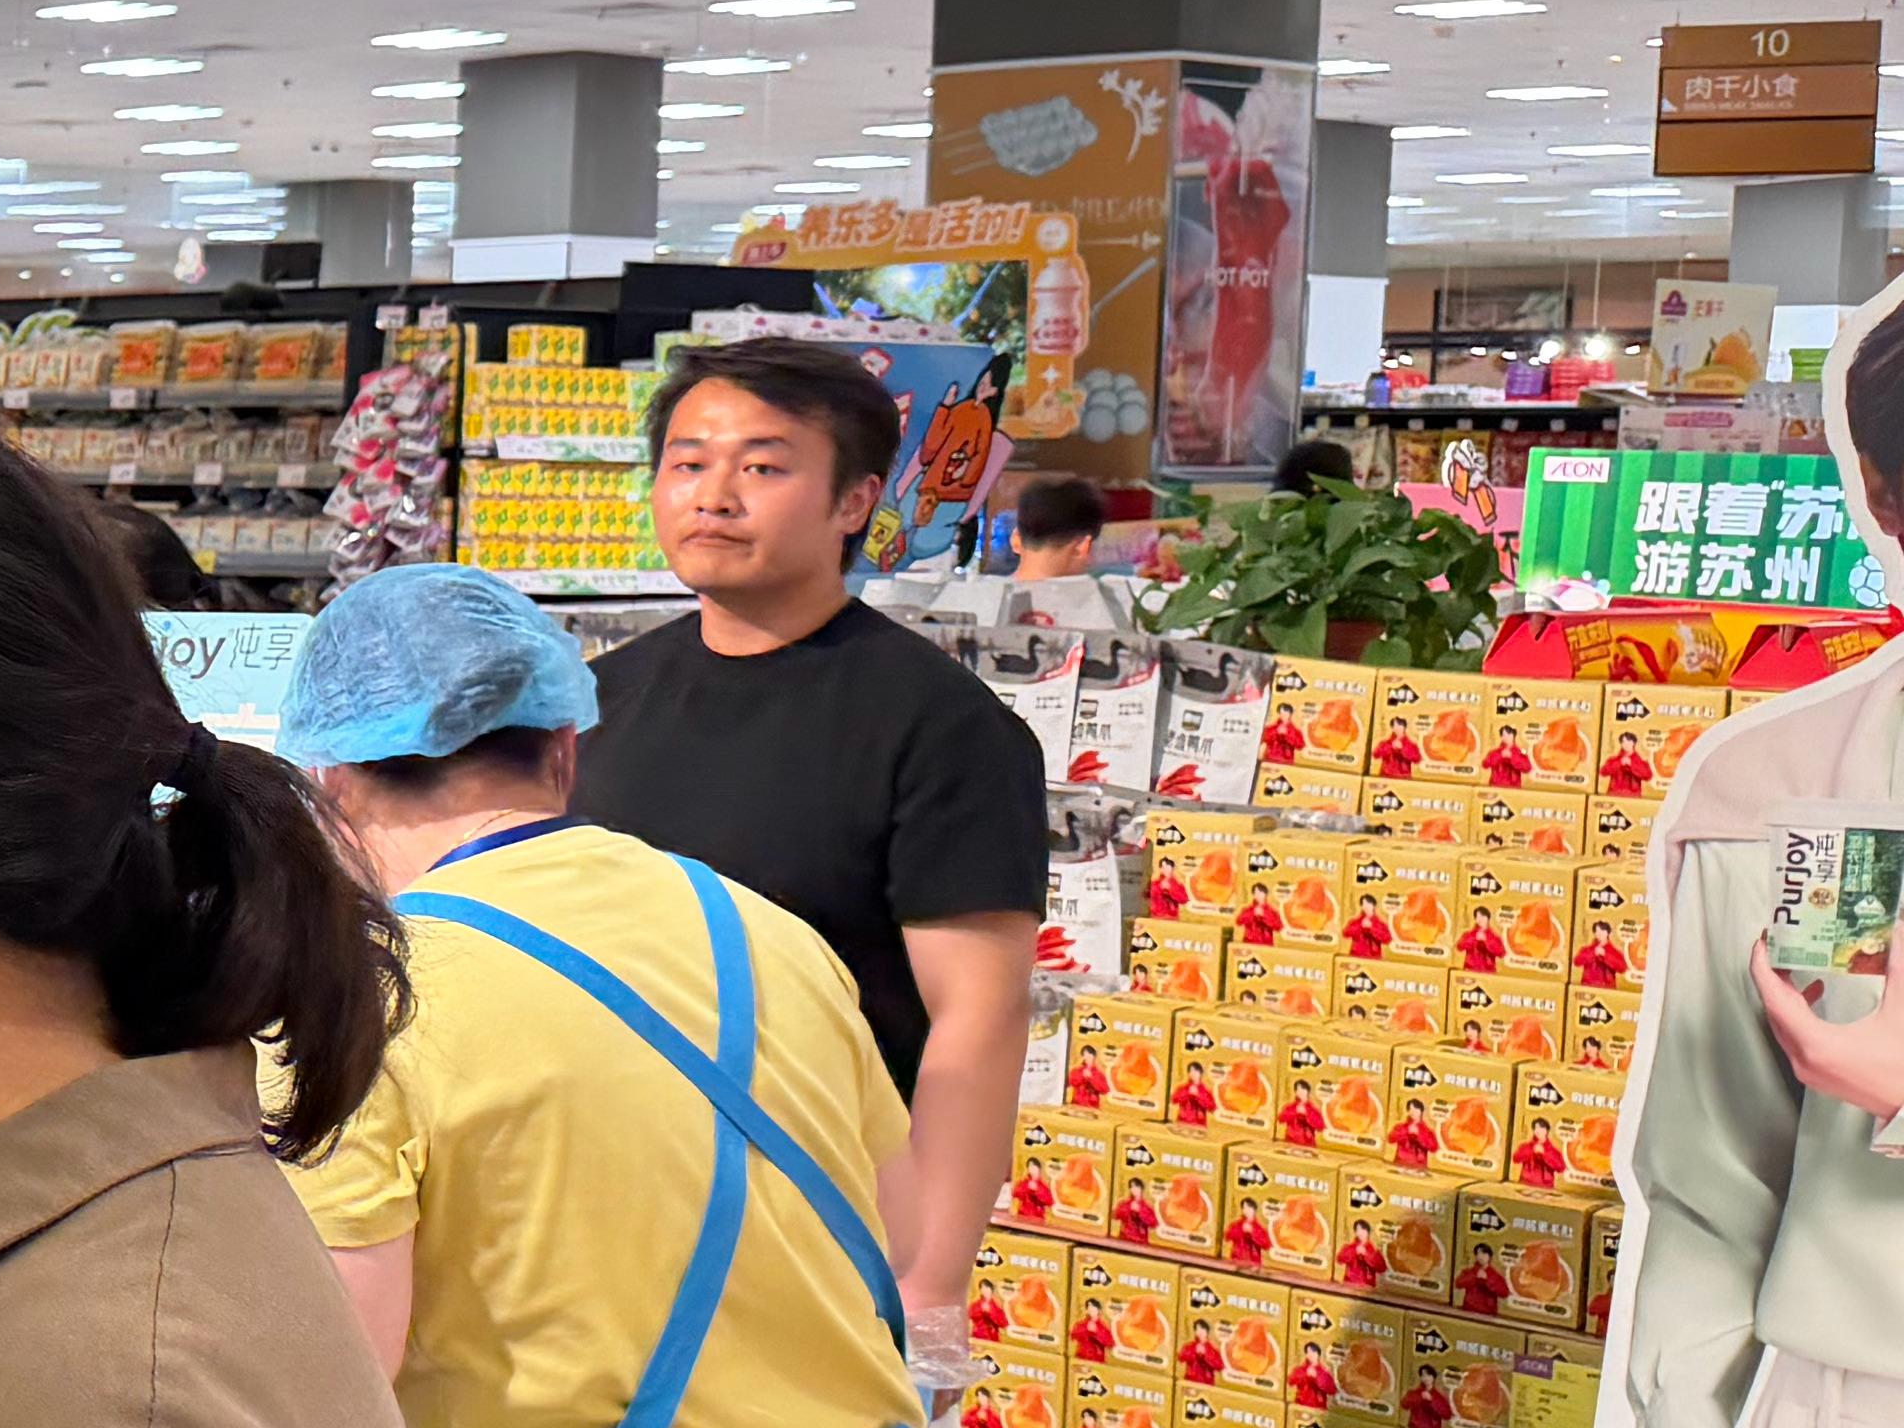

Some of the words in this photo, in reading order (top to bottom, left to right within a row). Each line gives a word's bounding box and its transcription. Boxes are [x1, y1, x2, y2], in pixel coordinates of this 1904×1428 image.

[1751, 29, 1791, 58] 10
[1685, 73, 1799, 101] 肉干小食
[1240, 268, 1270, 287] POT
[1633, 480, 1860, 541] 跟着“苏
[1630, 540, 1823, 603] 游苏州
[1774, 831, 1814, 926] Purjoy
